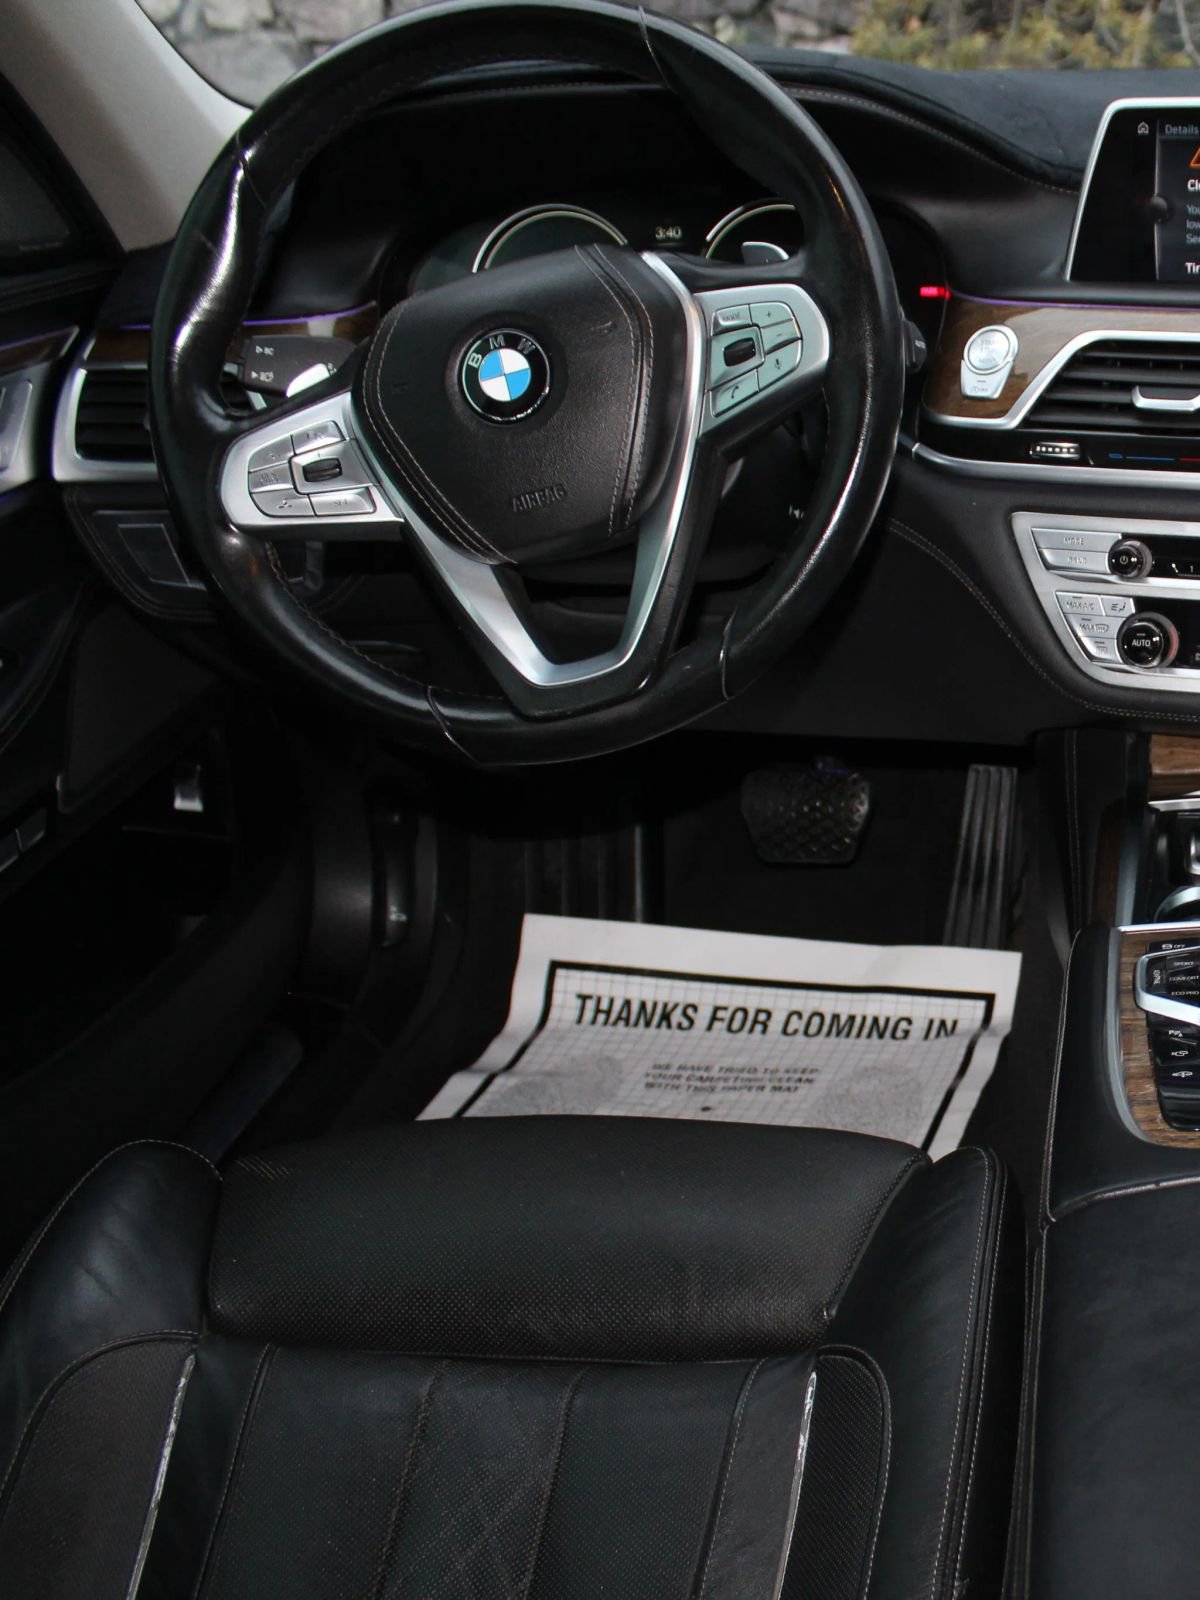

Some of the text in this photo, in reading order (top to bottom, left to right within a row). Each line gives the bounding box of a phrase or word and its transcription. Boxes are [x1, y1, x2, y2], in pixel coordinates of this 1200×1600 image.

[1165, 125, 1199, 135] Details
[655, 226, 682, 240] 3:40
[468, 334, 536, 369] BMW
[512, 485, 565, 512] AIRBAG
[1078, 623, 1095, 631] MAX
[1131, 639, 1150, 648] AUTO
[575, 993, 959, 1042] THANKS FOR COMING IN
